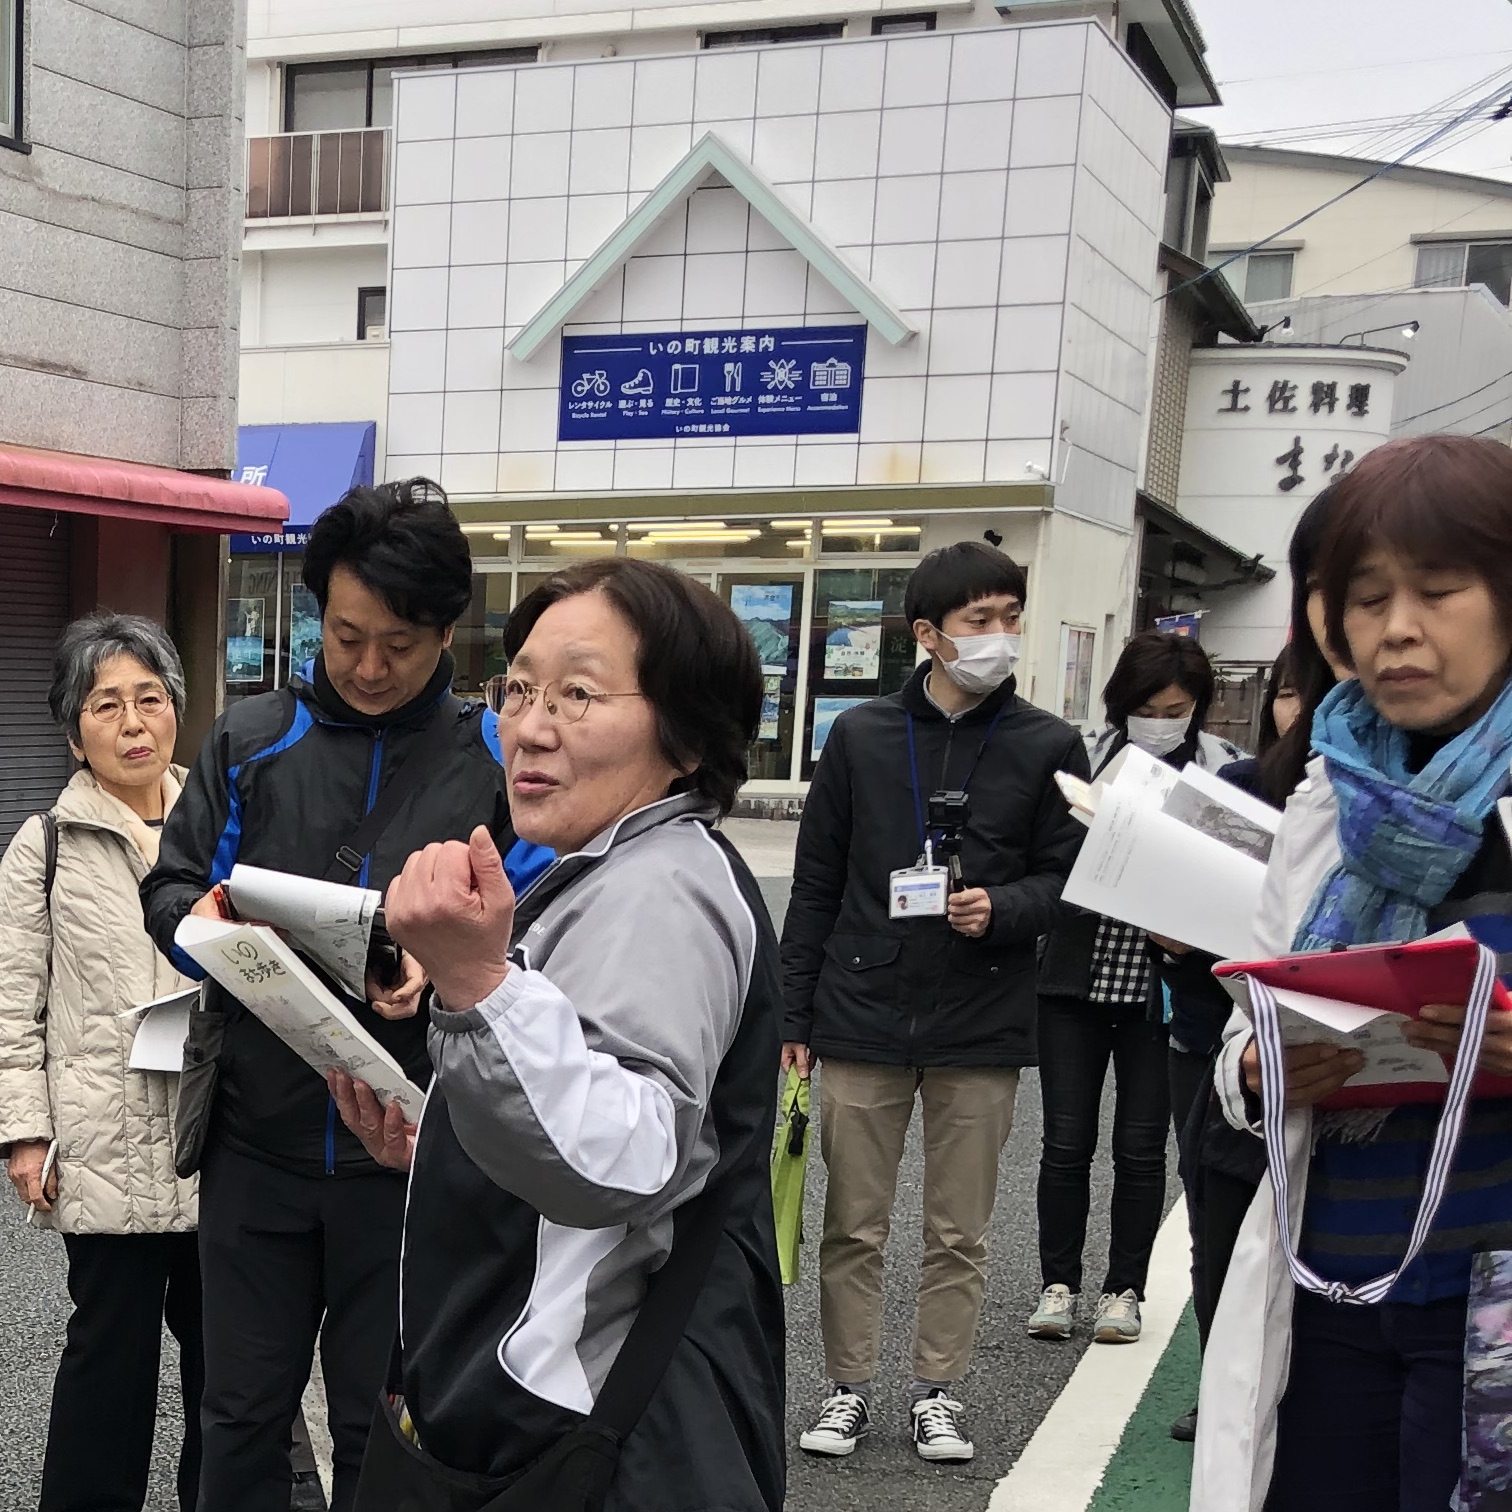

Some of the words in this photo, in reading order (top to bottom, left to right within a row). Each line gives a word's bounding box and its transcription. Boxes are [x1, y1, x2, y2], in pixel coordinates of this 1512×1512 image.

[649, 334, 775, 355] いの町観光案内
[568, 400, 613, 410] レンタサイクル
[1217, 379, 1371, 417] 土佐料理
[221, 941, 259, 965] いの
